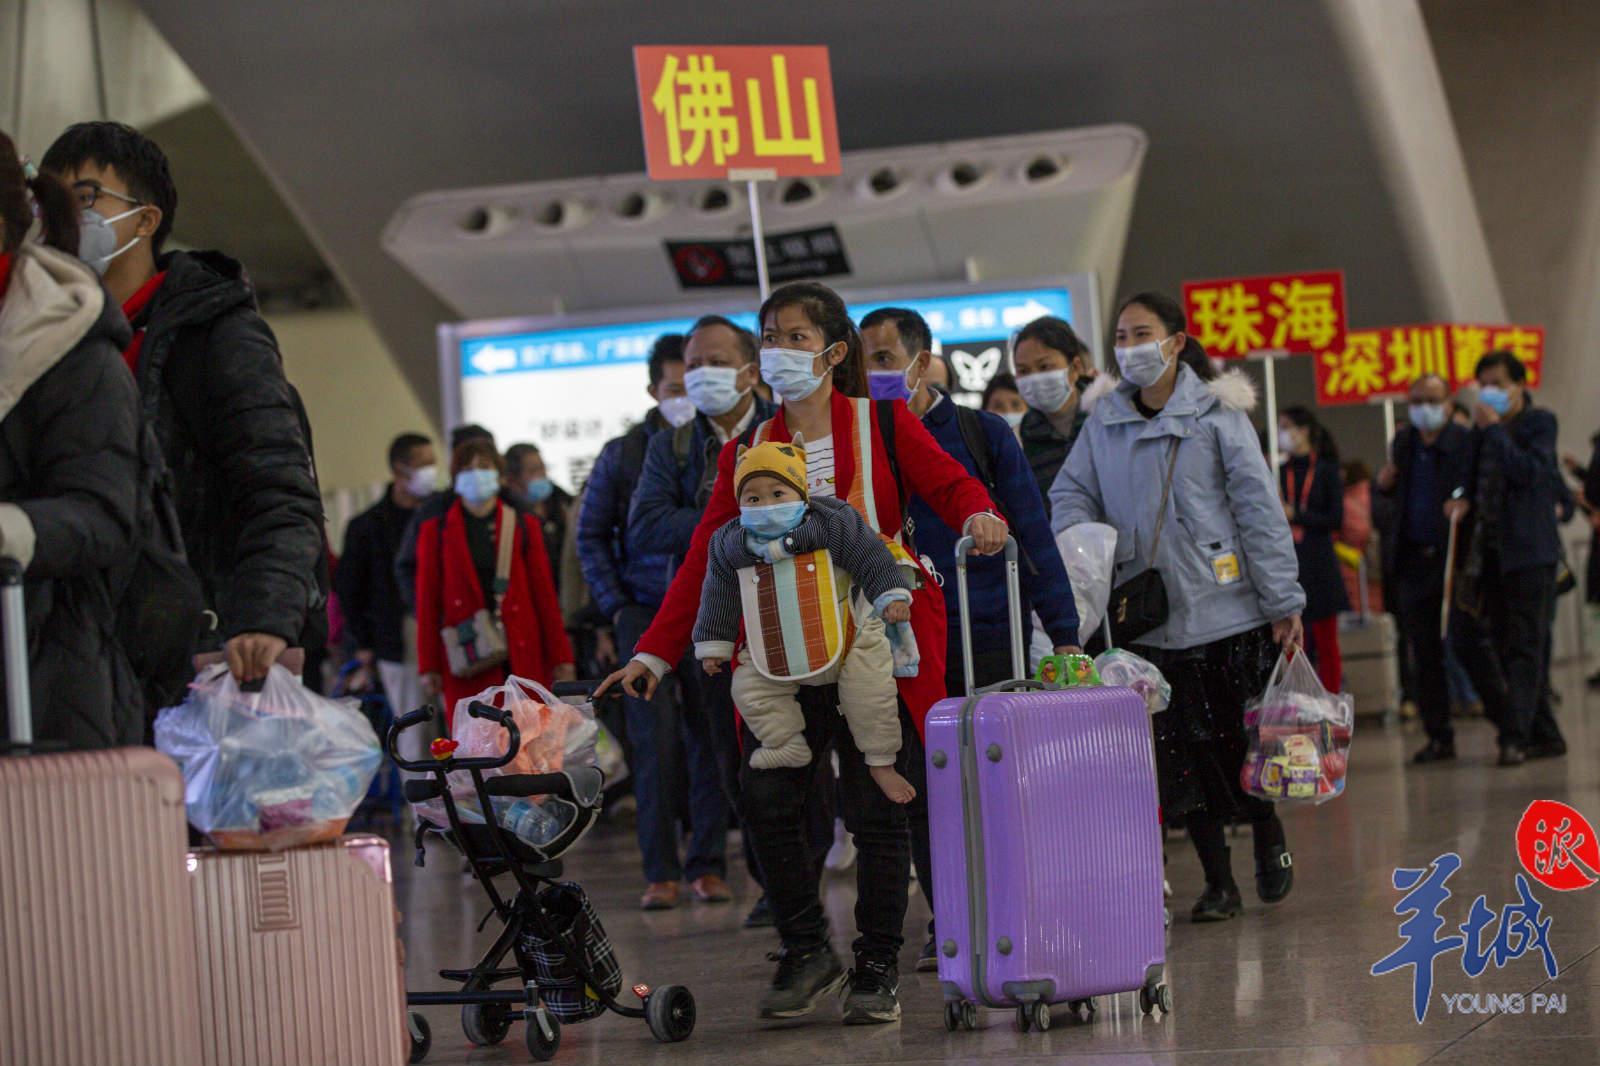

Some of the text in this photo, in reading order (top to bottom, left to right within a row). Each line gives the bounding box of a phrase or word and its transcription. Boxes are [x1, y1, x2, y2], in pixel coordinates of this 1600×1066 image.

[652, 54, 826, 166] 佛山
[1190, 279, 1338, 354] 珠海
[1322, 326, 1450, 395] 深圳
